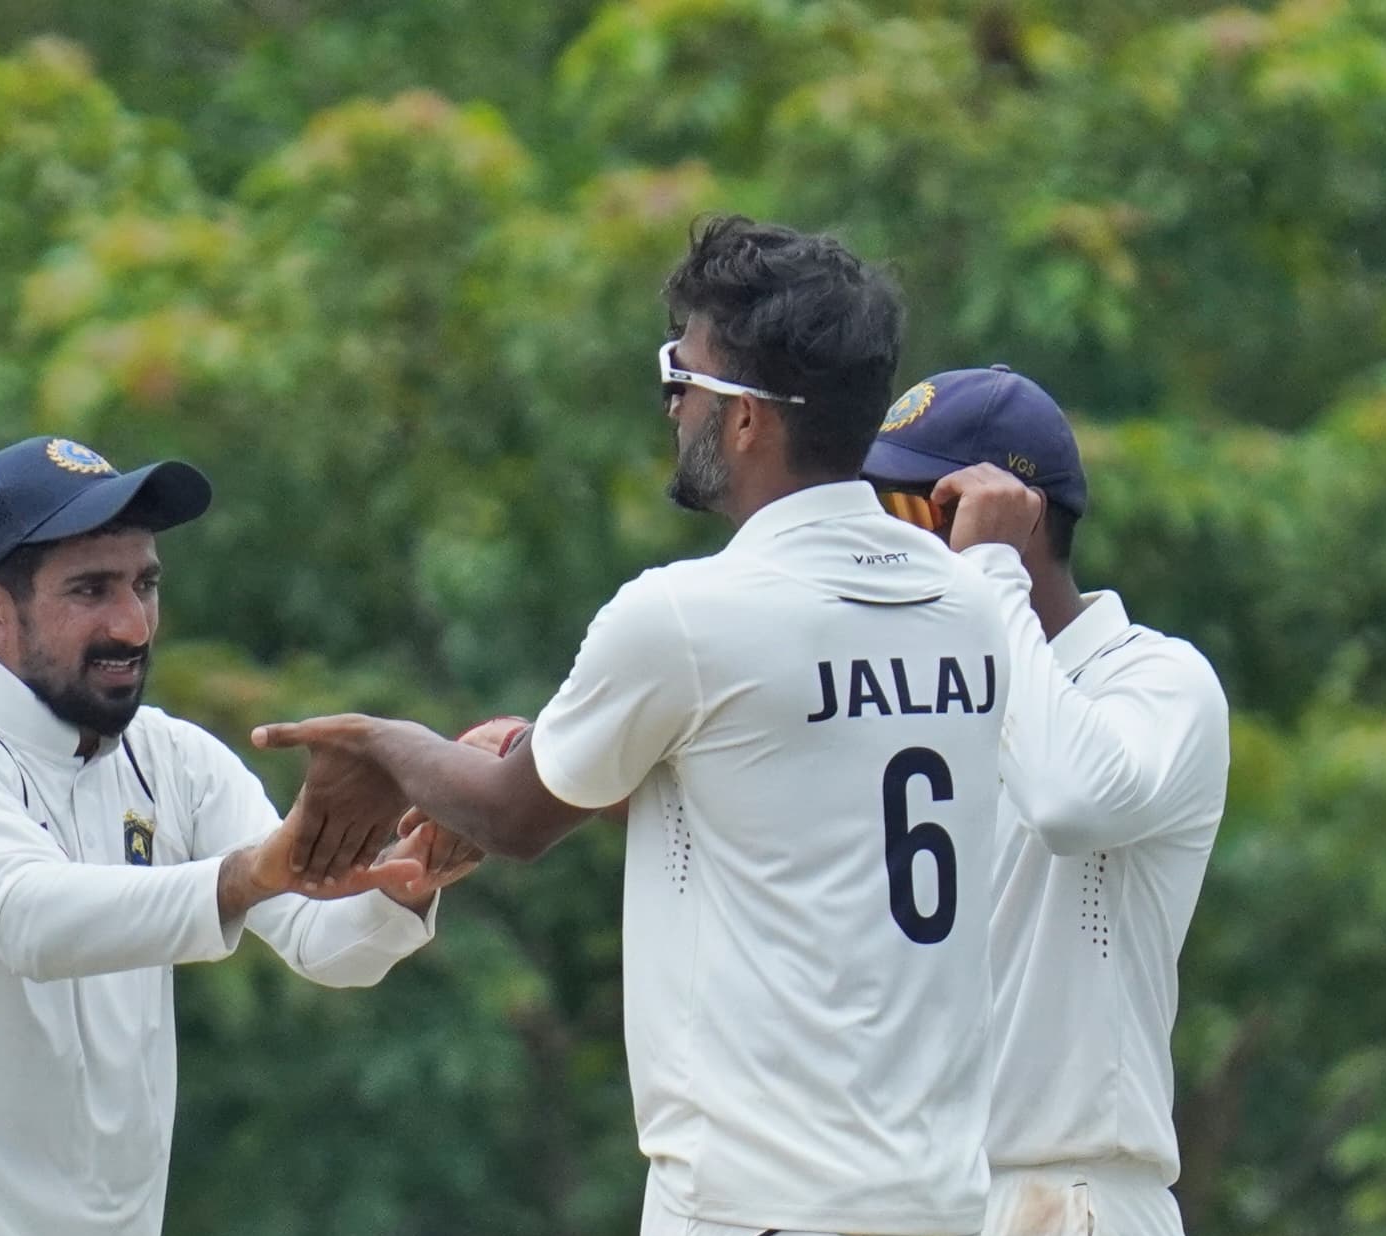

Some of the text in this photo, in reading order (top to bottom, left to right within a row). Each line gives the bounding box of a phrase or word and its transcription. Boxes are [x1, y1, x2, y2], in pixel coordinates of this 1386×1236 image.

[1008, 451, 1038, 478] VGS
[851, 552, 910, 566] VIRAT
[807, 654, 997, 723] JALAJ
[882, 746, 957, 945] 6
